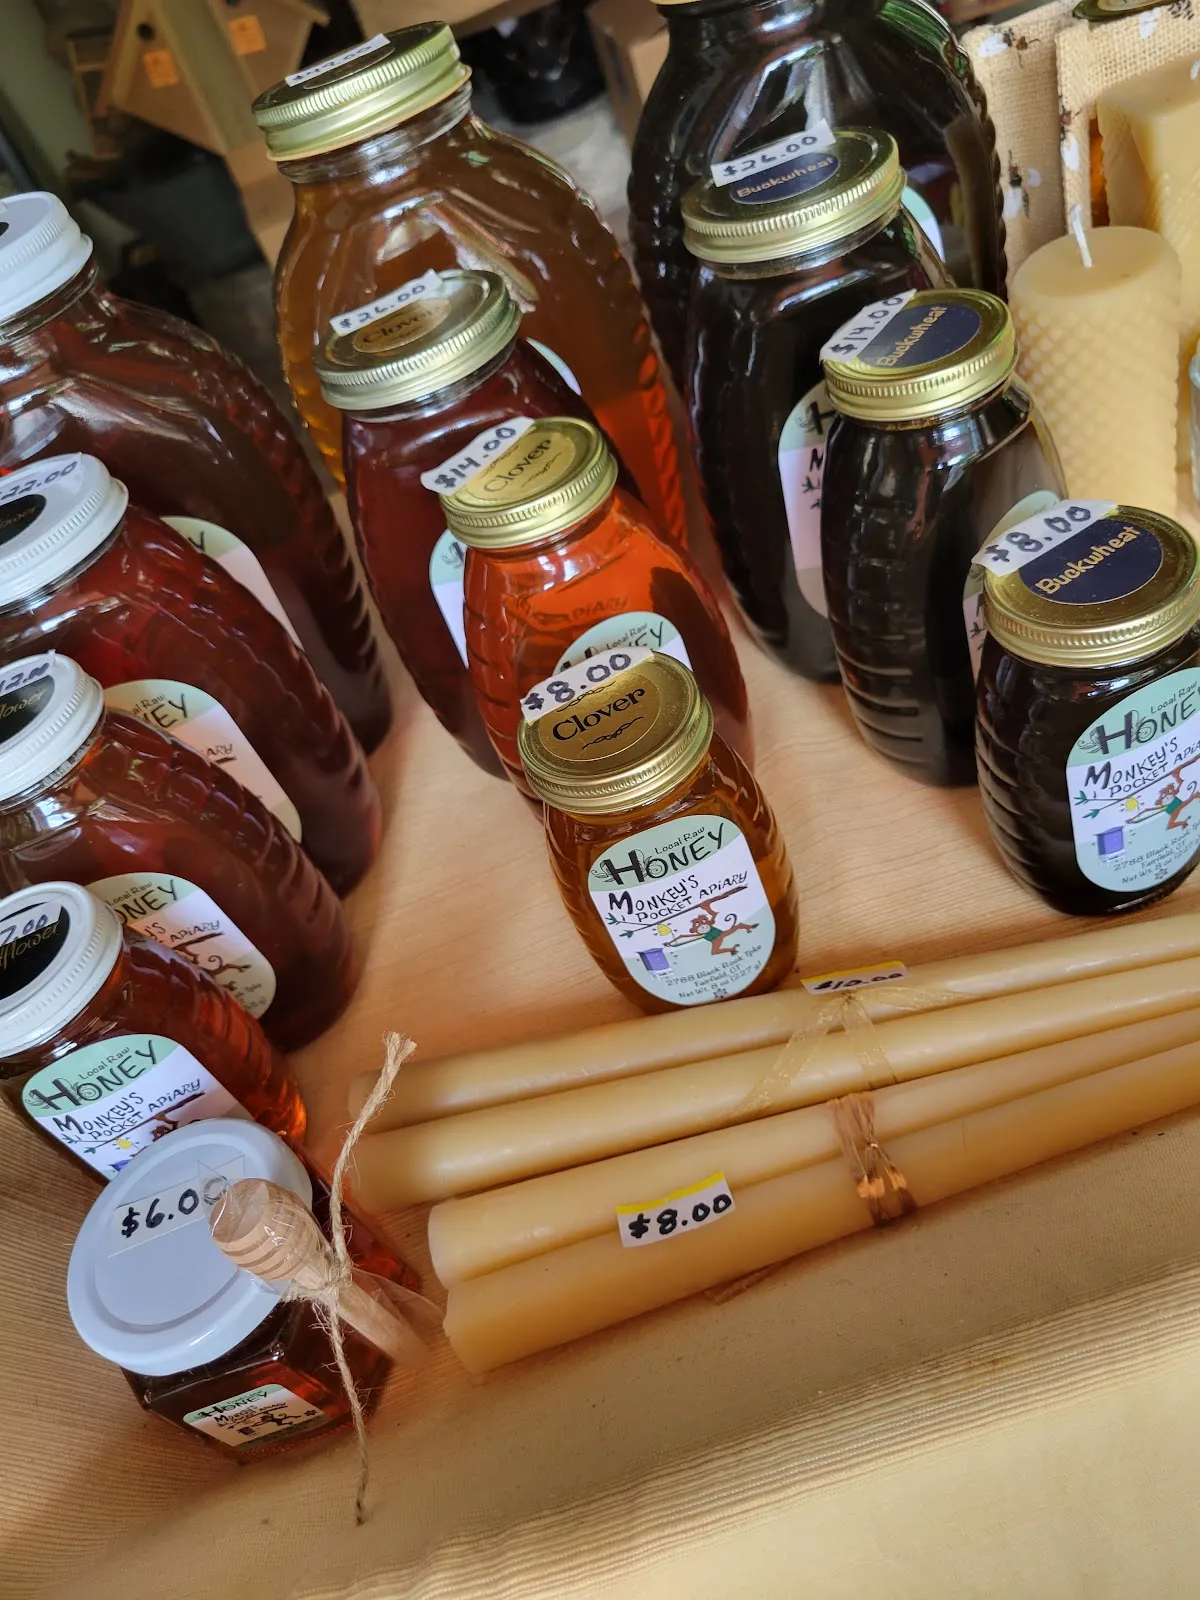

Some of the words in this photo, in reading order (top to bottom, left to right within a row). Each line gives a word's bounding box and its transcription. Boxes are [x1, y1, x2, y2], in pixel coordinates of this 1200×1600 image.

[724, 136, 818, 177] $26.00
[736, 157, 835, 198] Buckwheat
[829, 298, 903, 355] $14.00
[876, 306, 948, 367] Buckwheat
[434, 427, 516, 489] $14.00
[483, 439, 552, 493] Clover
[984, 506, 1091, 563] $8.00
[1034, 526, 1141, 594] Buckwheat
[523, 653, 632, 712] $8.00
[1151, 693, 1176, 715] Local
[1178, 680, 1198, 699] Raw
[552, 687, 646, 741] Clover
[1095, 686, 1200, 755] HONE
[1084, 737, 1178, 790] MONKEY'S
[1109, 762, 1168, 798] POCKET
[602, 822, 724, 886] HONEY
[654, 838, 683, 855] Local
[683, 826, 705, 843] Raw
[106, 891, 132, 907] Local
[132, 881, 152, 894] Raw
[112, 878, 178, 925] ONEY
[608, 874, 700, 915] MONKEY'S
[636, 896, 692, 925] POCKET
[666, 975, 695, 987] 2788
[696, 965, 720, 981] Black
[722, 955, 743, 970] Rock
[744, 944, 762, 960] Tpke
[679, 990, 694, 999] Net
[30, 1039, 158, 1111] HONEY
[78, 1061, 107, 1080] Local
[108, 1046, 130, 1064] Raw
[52, 1092, 144, 1135] MONKEY'S
[88, 1111, 144, 1140] POCKET
[628, 1194, 732, 1239] $8.00
[198, 1391, 268, 1418] HONEY
